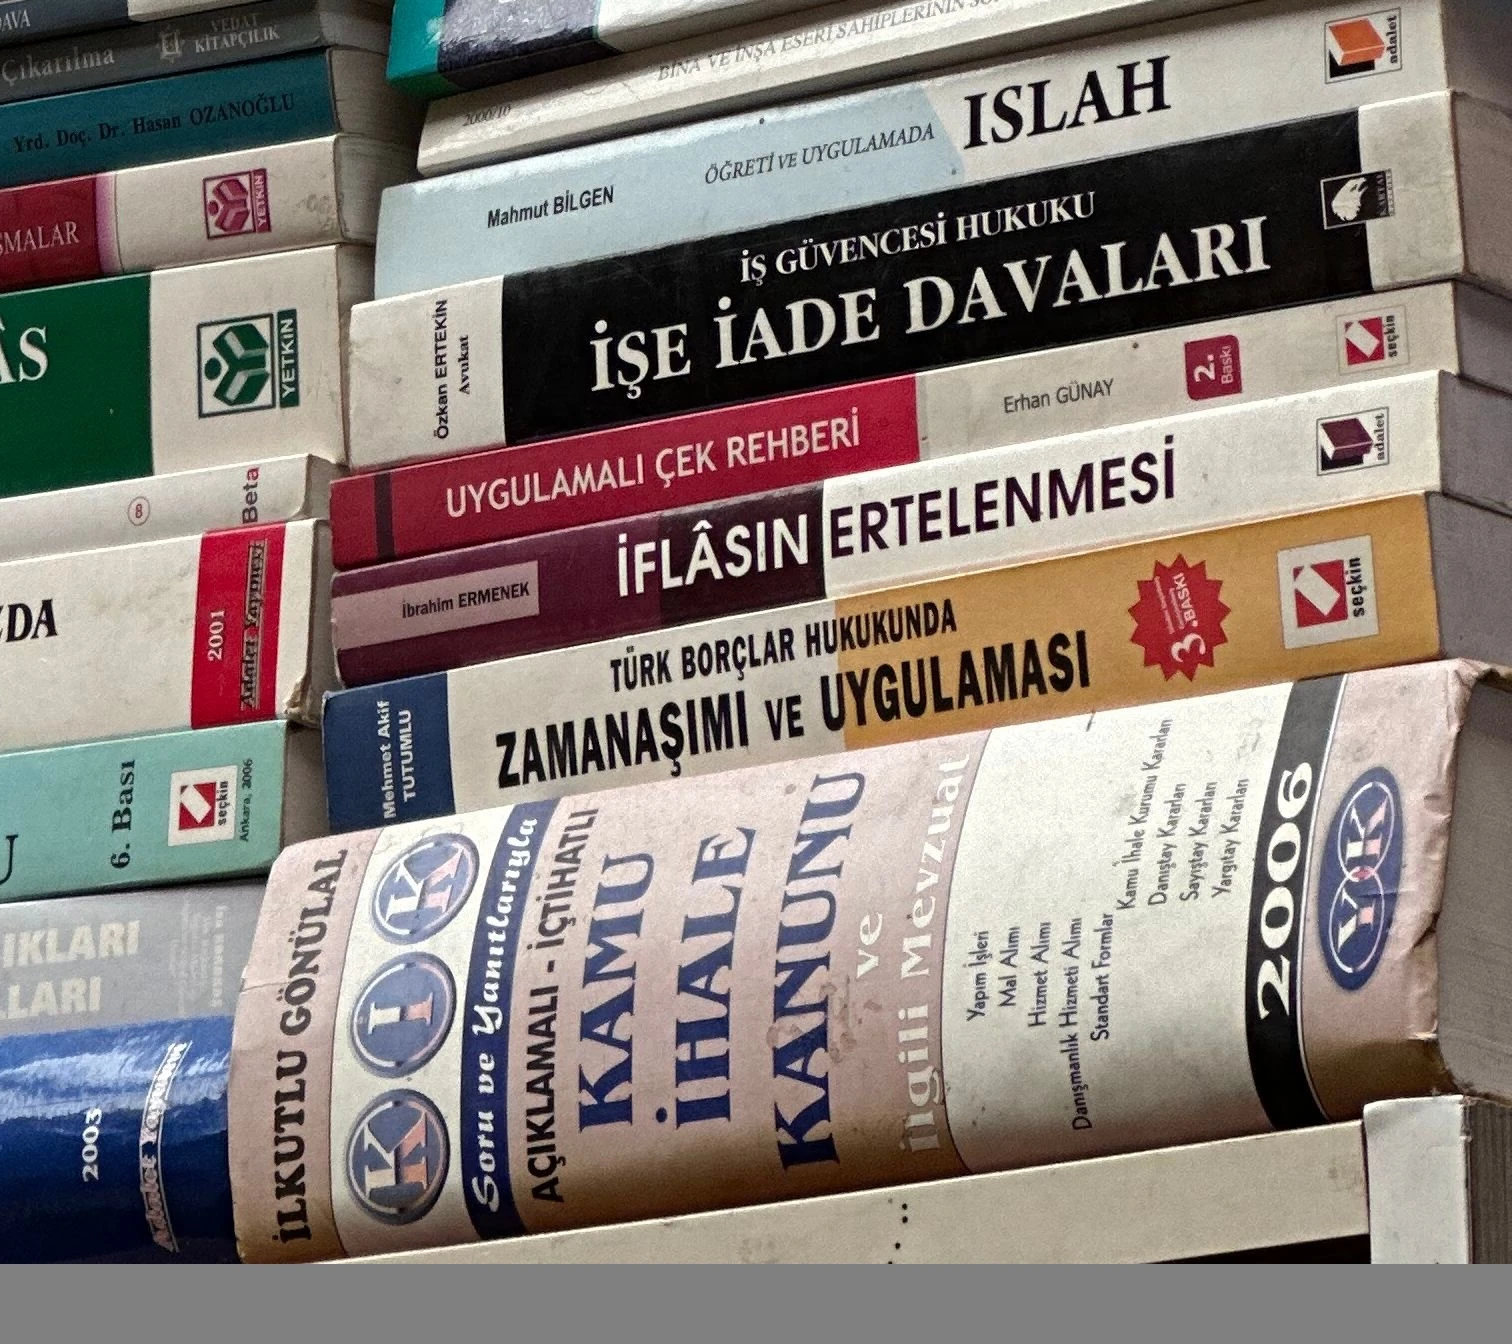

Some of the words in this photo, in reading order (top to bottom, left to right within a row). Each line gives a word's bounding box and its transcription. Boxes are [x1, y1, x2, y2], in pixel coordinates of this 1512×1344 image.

[963, 55, 1172, 149] ISLAH
[1388, 16, 1399, 64] adalet
[488, 201, 550, 228] Mahmut
[554, 185, 615, 215] BİLGEN
[591, 321, 691, 399] İŞE
[714, 288, 880, 369] İADE
[906, 216, 1271, 334] DAVALARI
[446, 454, 645, 518] UYGULAMALI
[655, 442, 716, 489] ÇEK
[727, 408, 861, 469] REHBERİ
[1004, 391, 1051, 413] Erhan
[1056, 378, 1114, 404] GÜNAY
[617, 514, 809, 597] İFLÂSIN
[830, 434, 1176, 558] ERTELENMESİ
[1351, 556, 1365, 617] seçkin
[496, 687, 749, 789] ZAMANAŞIMI
[766, 696, 802, 730] VE
[820, 629, 1091, 734] UYGULAMASI
[110, 758, 136, 830] Bası
[110, 844, 132, 871] 6.
[279, 849, 347, 1035] GÖNÜLAL
[773, 772, 866, 1170] KANUNU
[1257, 762, 1313, 1020] 2006
[579, 853, 654, 1133] KAMU
[658, 826, 756, 1130] İHALE
[273, 1049, 309, 1245] İLKUTLU
